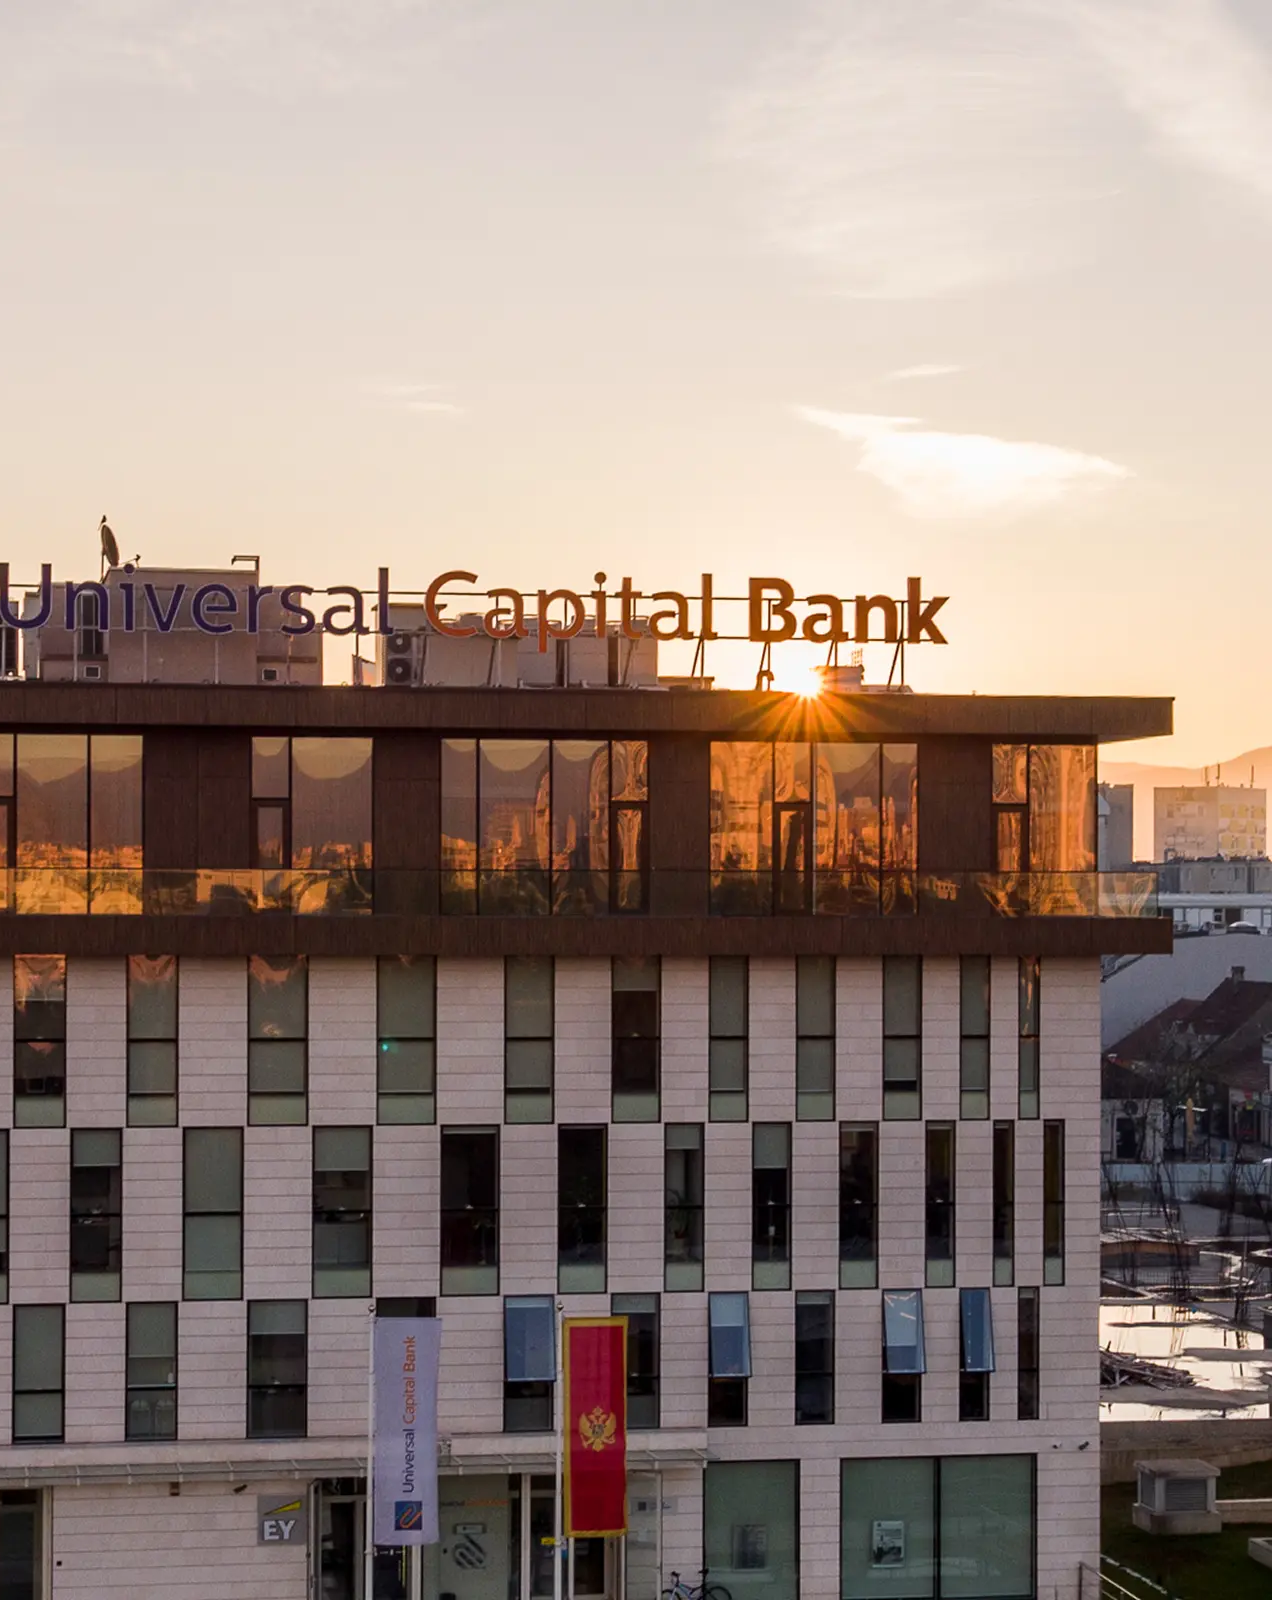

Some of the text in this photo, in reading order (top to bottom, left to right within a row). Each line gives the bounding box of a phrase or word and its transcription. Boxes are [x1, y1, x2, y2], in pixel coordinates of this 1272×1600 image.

[424, 569, 719, 653] Capital
[748, 576, 951, 645] Bank
[402, 1335, 418, 1494] Universal Capital Bank
[263, 1519, 297, 1541] EY
